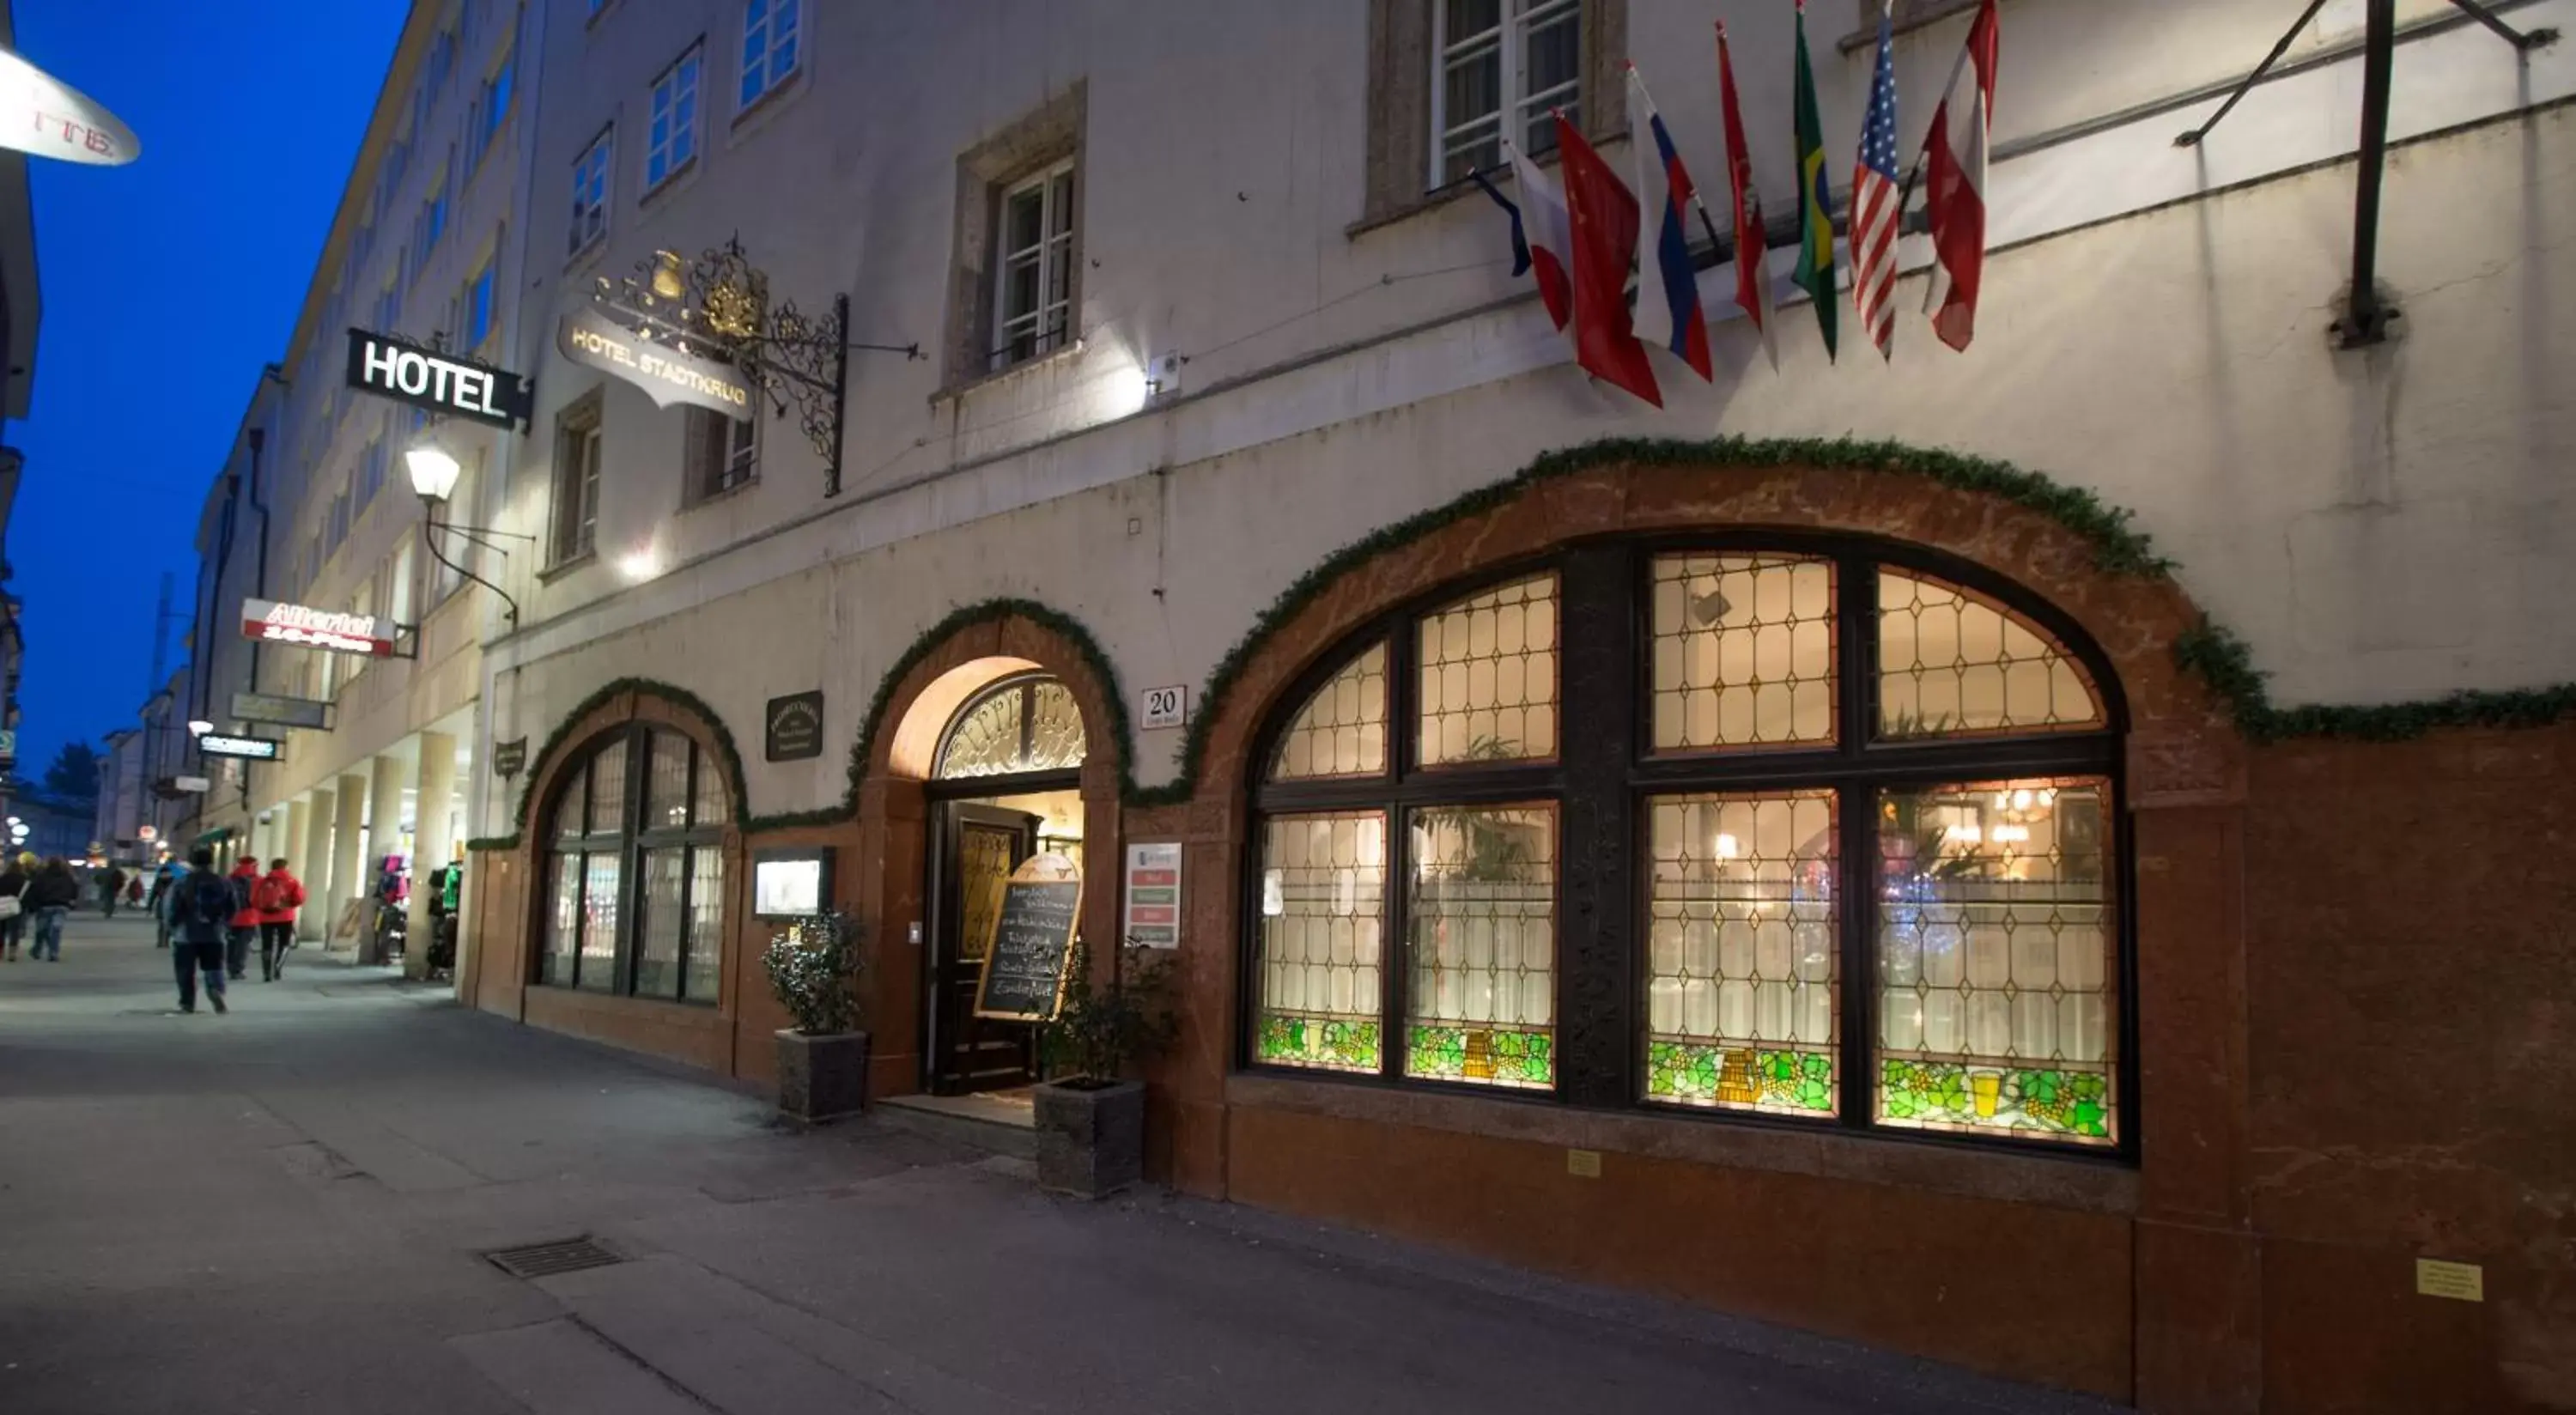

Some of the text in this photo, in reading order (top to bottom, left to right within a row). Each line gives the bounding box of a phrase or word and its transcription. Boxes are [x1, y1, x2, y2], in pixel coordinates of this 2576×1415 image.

[363, 341, 507, 417] HOTEL
[572, 326, 747, 406] HOTEL STADTKRUG
[1150, 689, 1176, 715] 20
